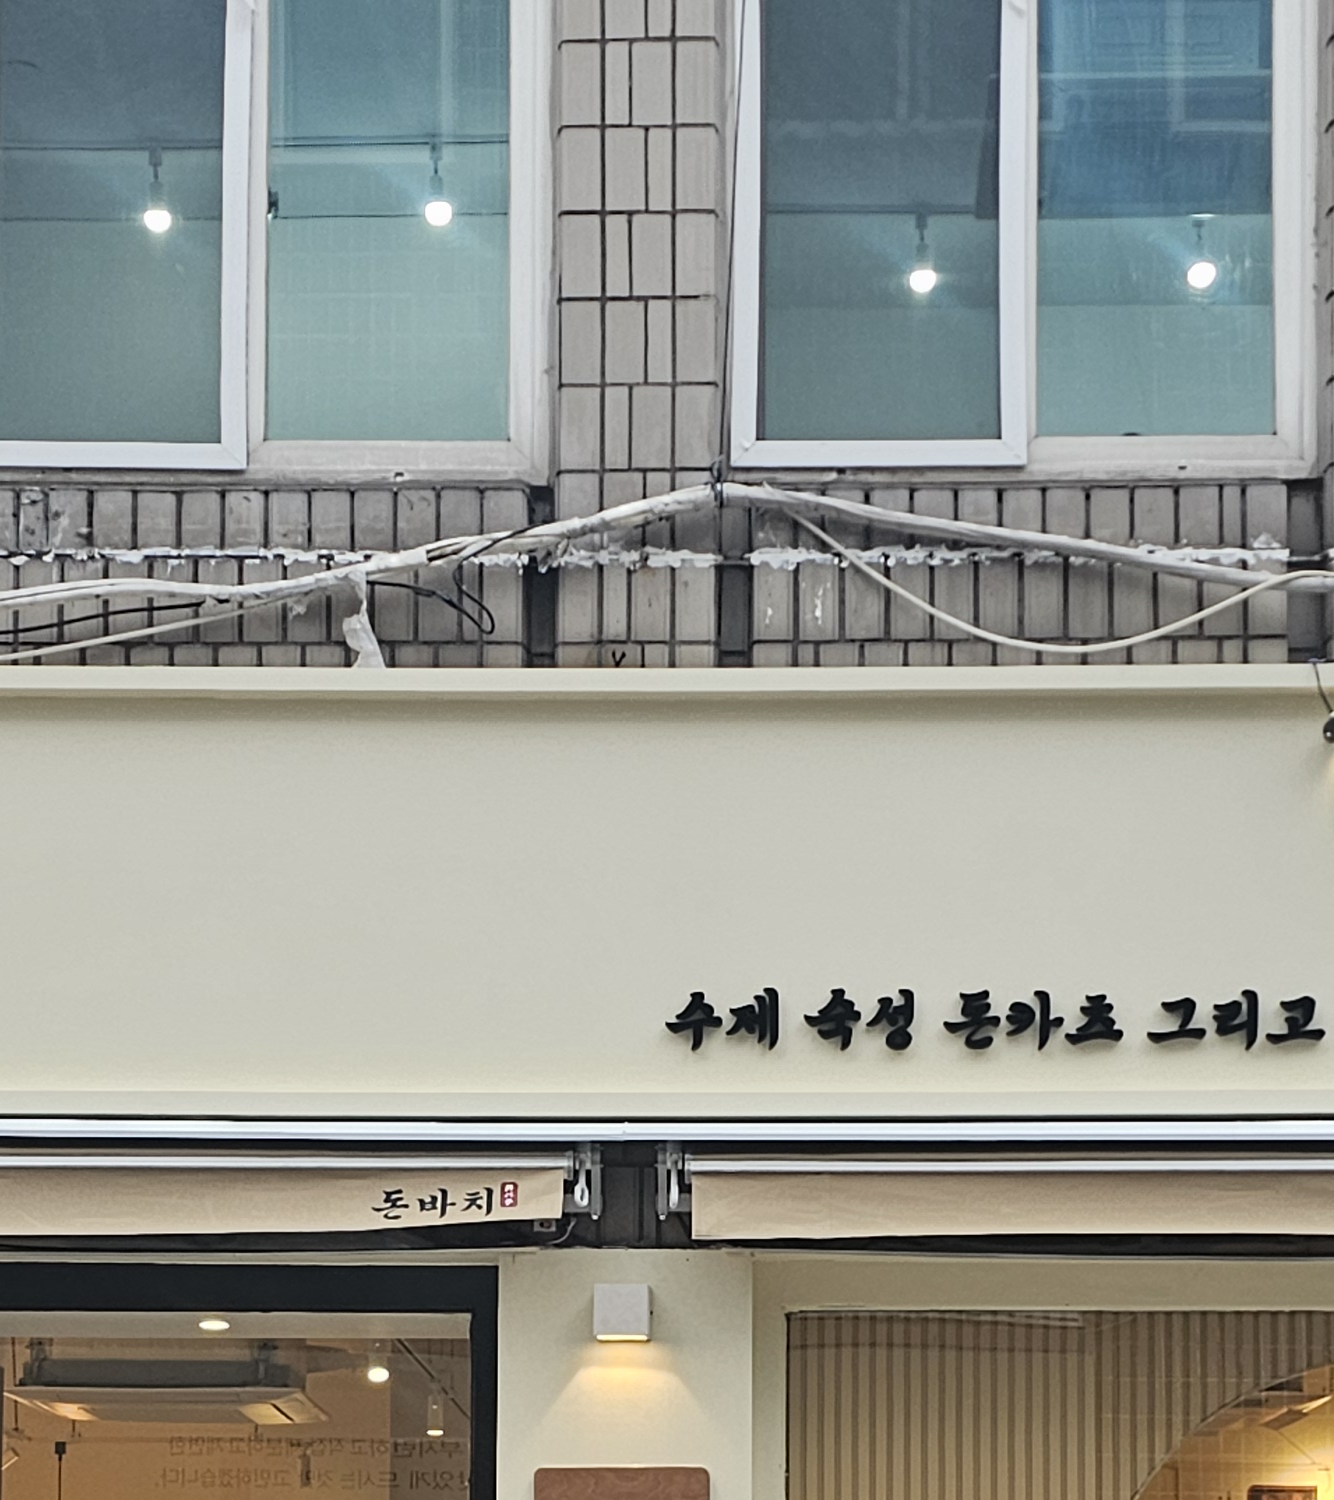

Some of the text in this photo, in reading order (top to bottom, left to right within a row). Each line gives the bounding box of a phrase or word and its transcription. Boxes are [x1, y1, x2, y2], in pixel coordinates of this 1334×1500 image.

[665, 987, 779, 1051] 수제
[803, 988, 915, 1051] 숙성
[942, 989, 1124, 1051] 돈카츠
[1146, 989, 1326, 1052] 그리고
[371, 1186, 494, 1220] 돈바치
